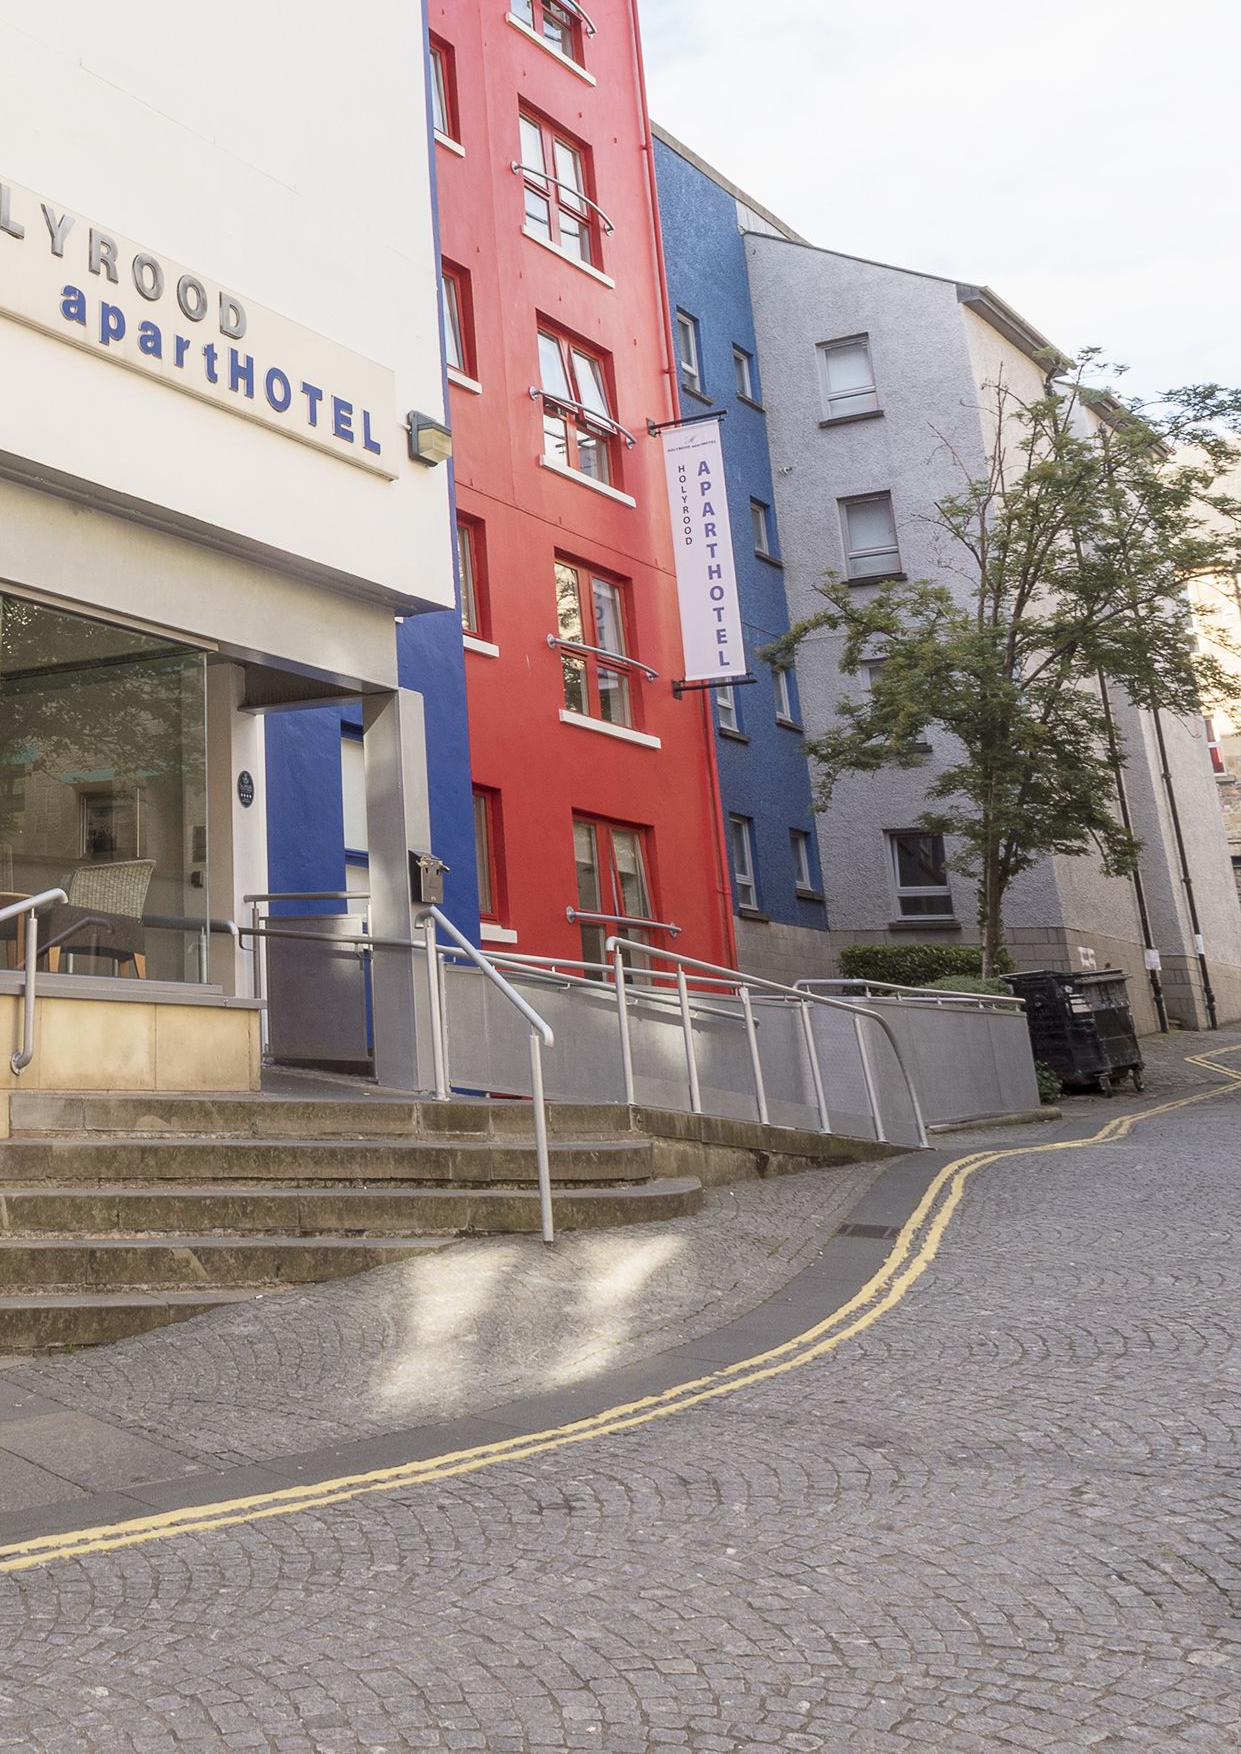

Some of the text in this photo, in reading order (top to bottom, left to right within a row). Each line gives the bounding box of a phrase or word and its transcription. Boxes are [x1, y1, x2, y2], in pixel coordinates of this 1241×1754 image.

[60, 284, 381, 455] apartHOTEL
[678, 465, 693, 546] HOLYROOD
[697, 460, 730, 667] APARTHOTEL
